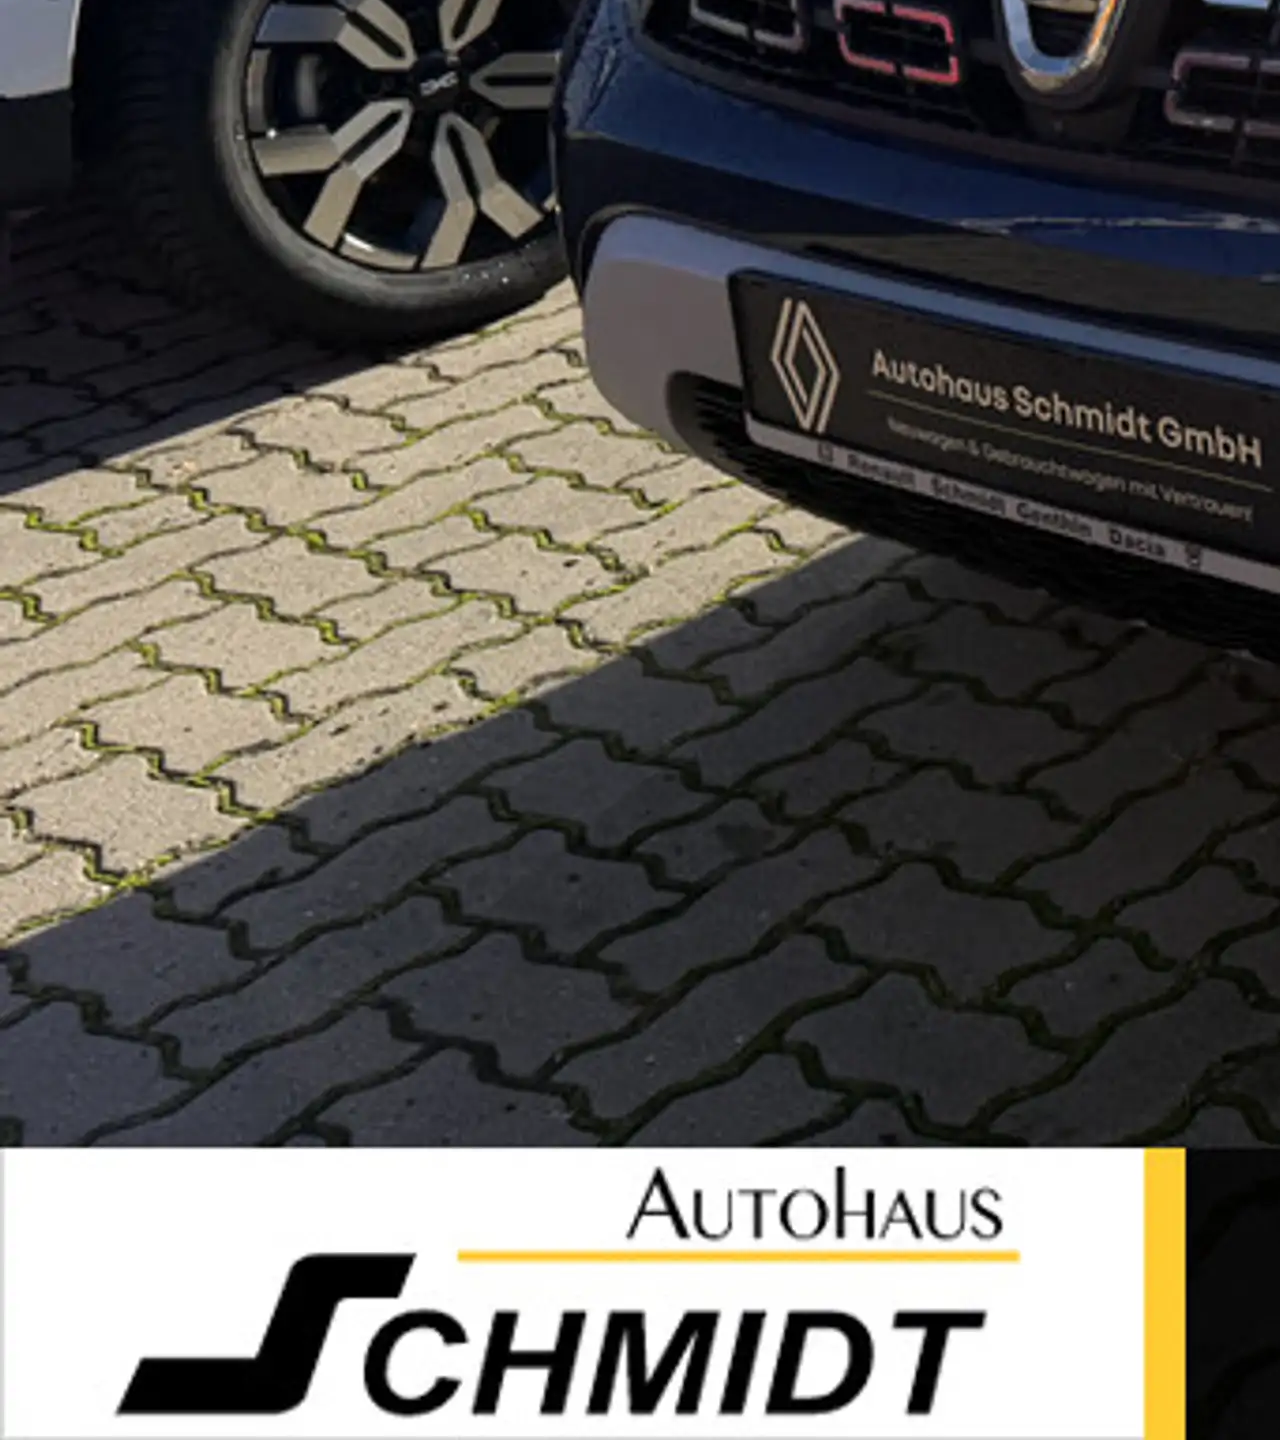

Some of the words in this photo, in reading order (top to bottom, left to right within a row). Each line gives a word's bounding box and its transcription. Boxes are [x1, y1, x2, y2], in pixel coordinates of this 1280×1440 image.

[872, 348, 1009, 411] Autohaus
[1012, 385, 1151, 443] Schmidt
[1157, 416, 1262, 469] GmbH
[931, 474, 1006, 515] Schmidt
[1108, 528, 1166, 557] Dacia
[1129, 480, 1159, 501] mit
